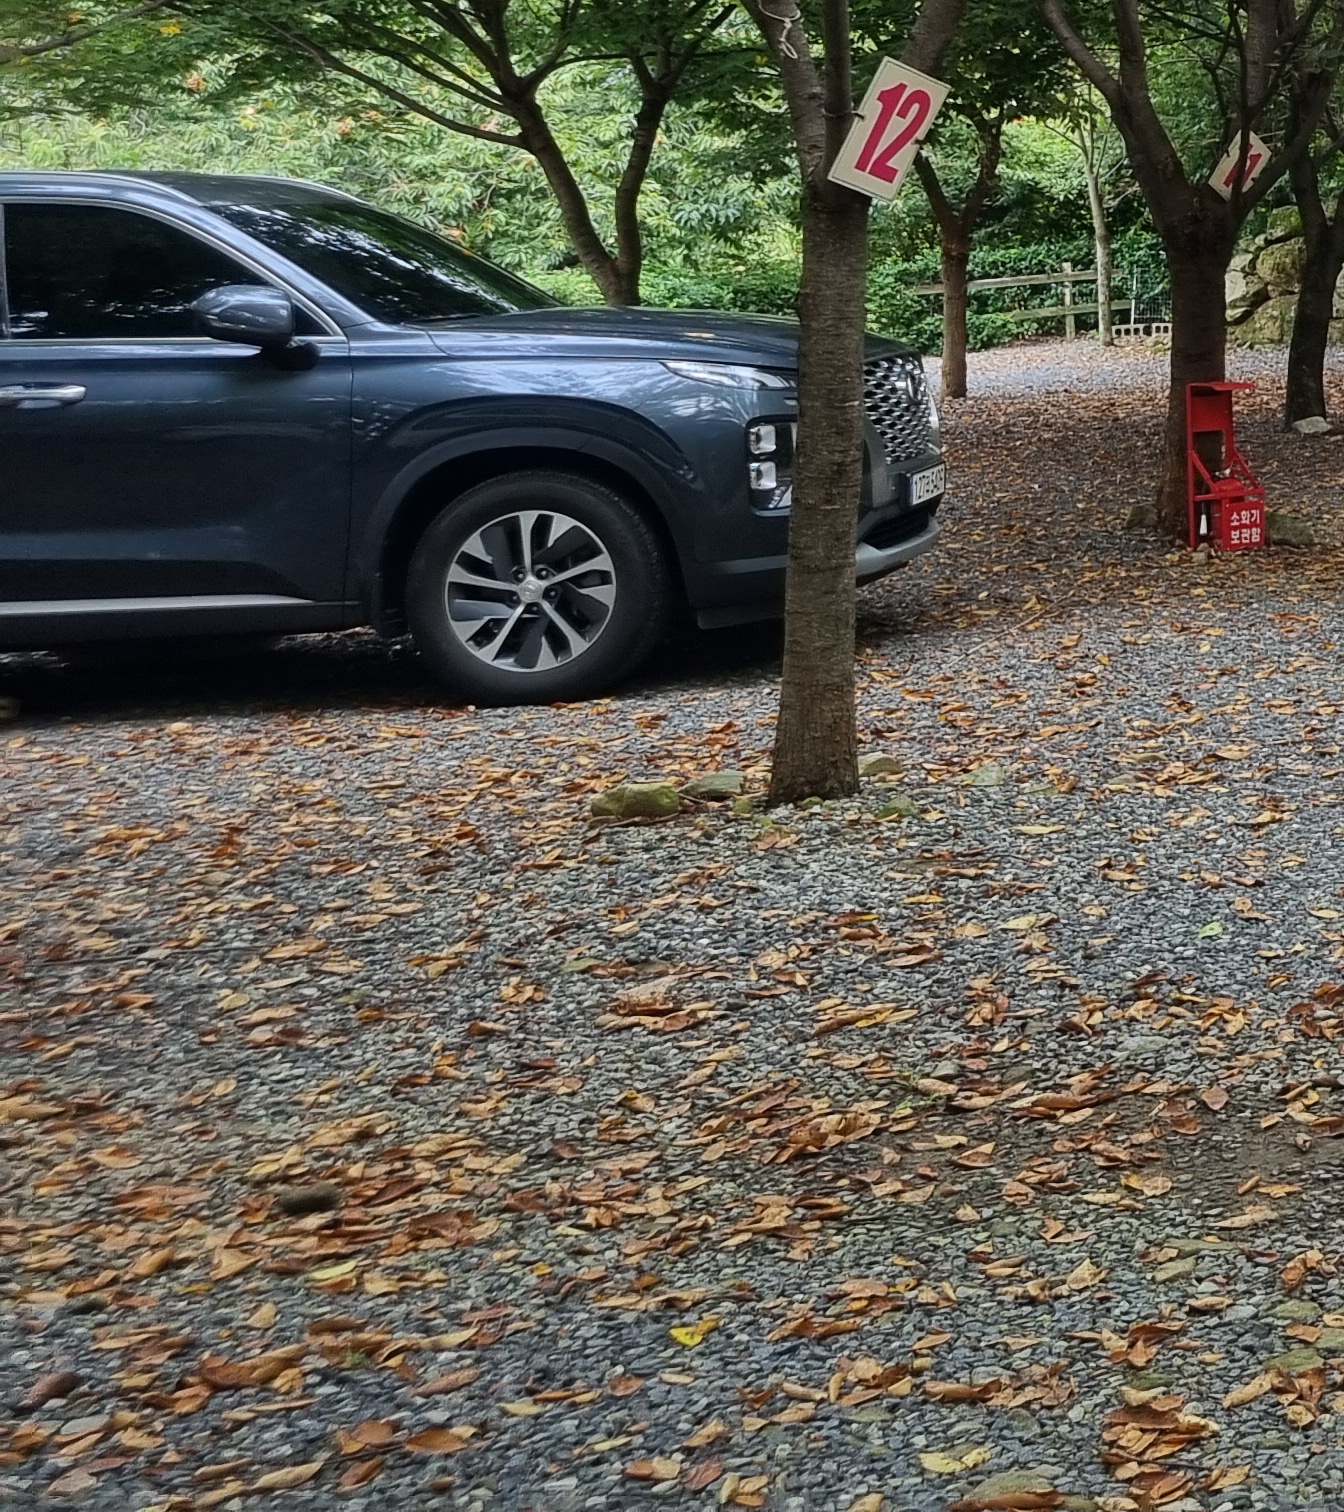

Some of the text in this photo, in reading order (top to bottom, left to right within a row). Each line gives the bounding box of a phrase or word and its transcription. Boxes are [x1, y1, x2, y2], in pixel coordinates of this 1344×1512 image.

[854, 81, 932, 185] 12
[1230, 509, 1261, 526] 소화기
[1230, 527, 1261, 544] 보관함
